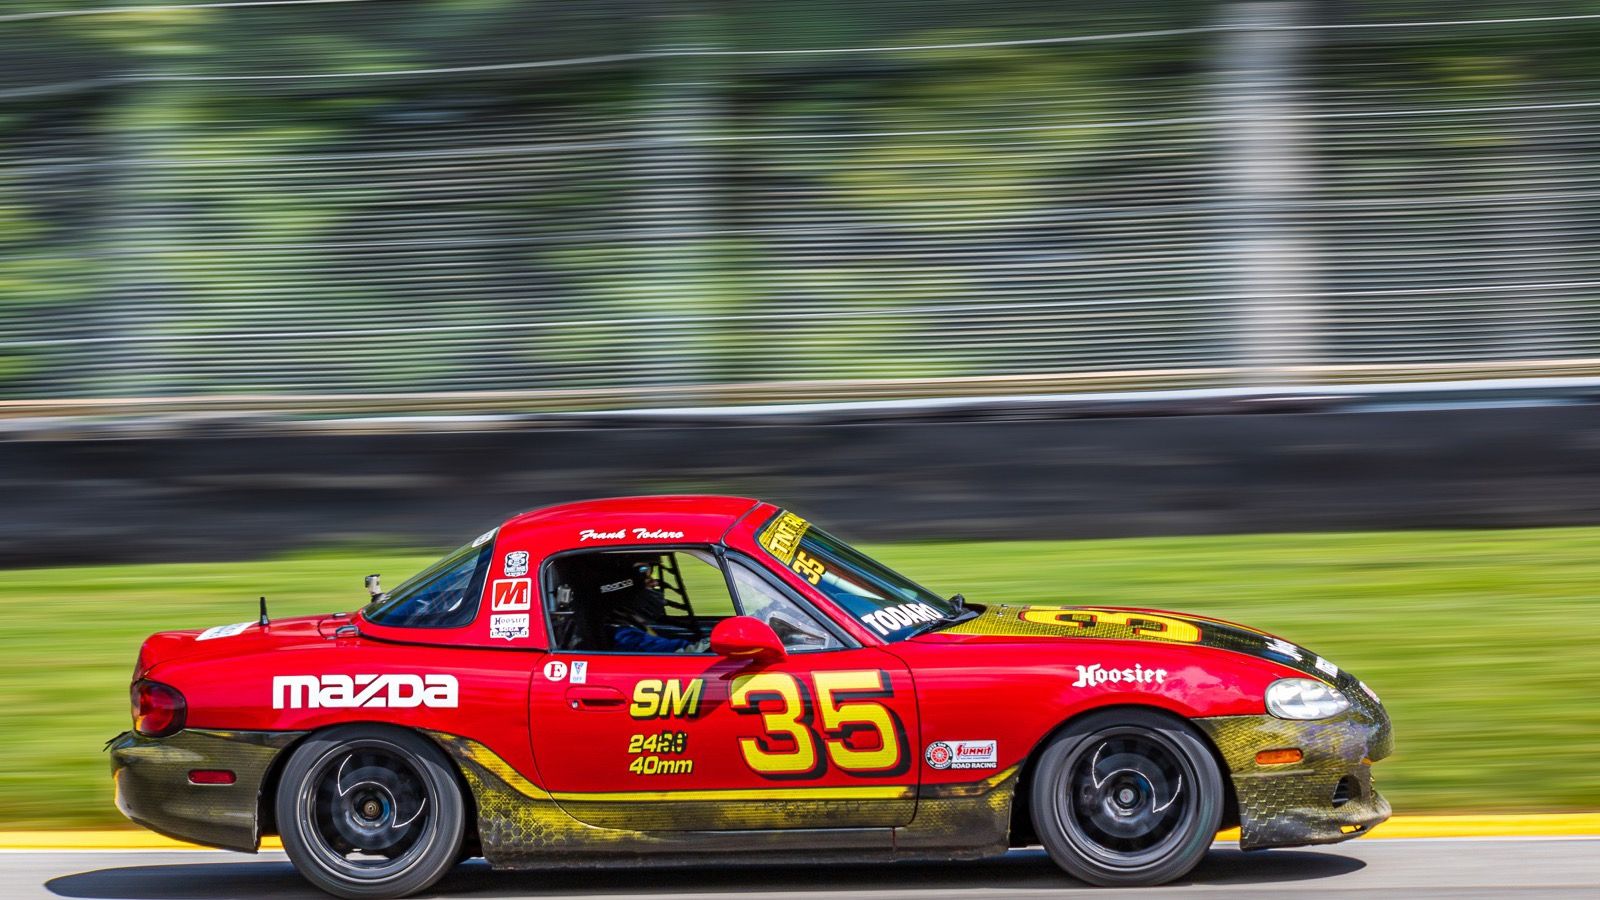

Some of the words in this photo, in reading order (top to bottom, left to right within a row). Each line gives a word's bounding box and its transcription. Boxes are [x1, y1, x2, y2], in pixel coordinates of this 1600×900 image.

[579, 529, 627, 541] Frank
[632, 528, 684, 539] Todaro
[792, 551, 825, 585] 35
[860, 603, 943, 636] TODARO
[549, 664, 563, 678] E
[1072, 663, 1168, 688] Hoosier
[629, 678, 704, 719] SM
[728, 669, 910, 779] 35
[628, 756, 693, 775] 40mm
